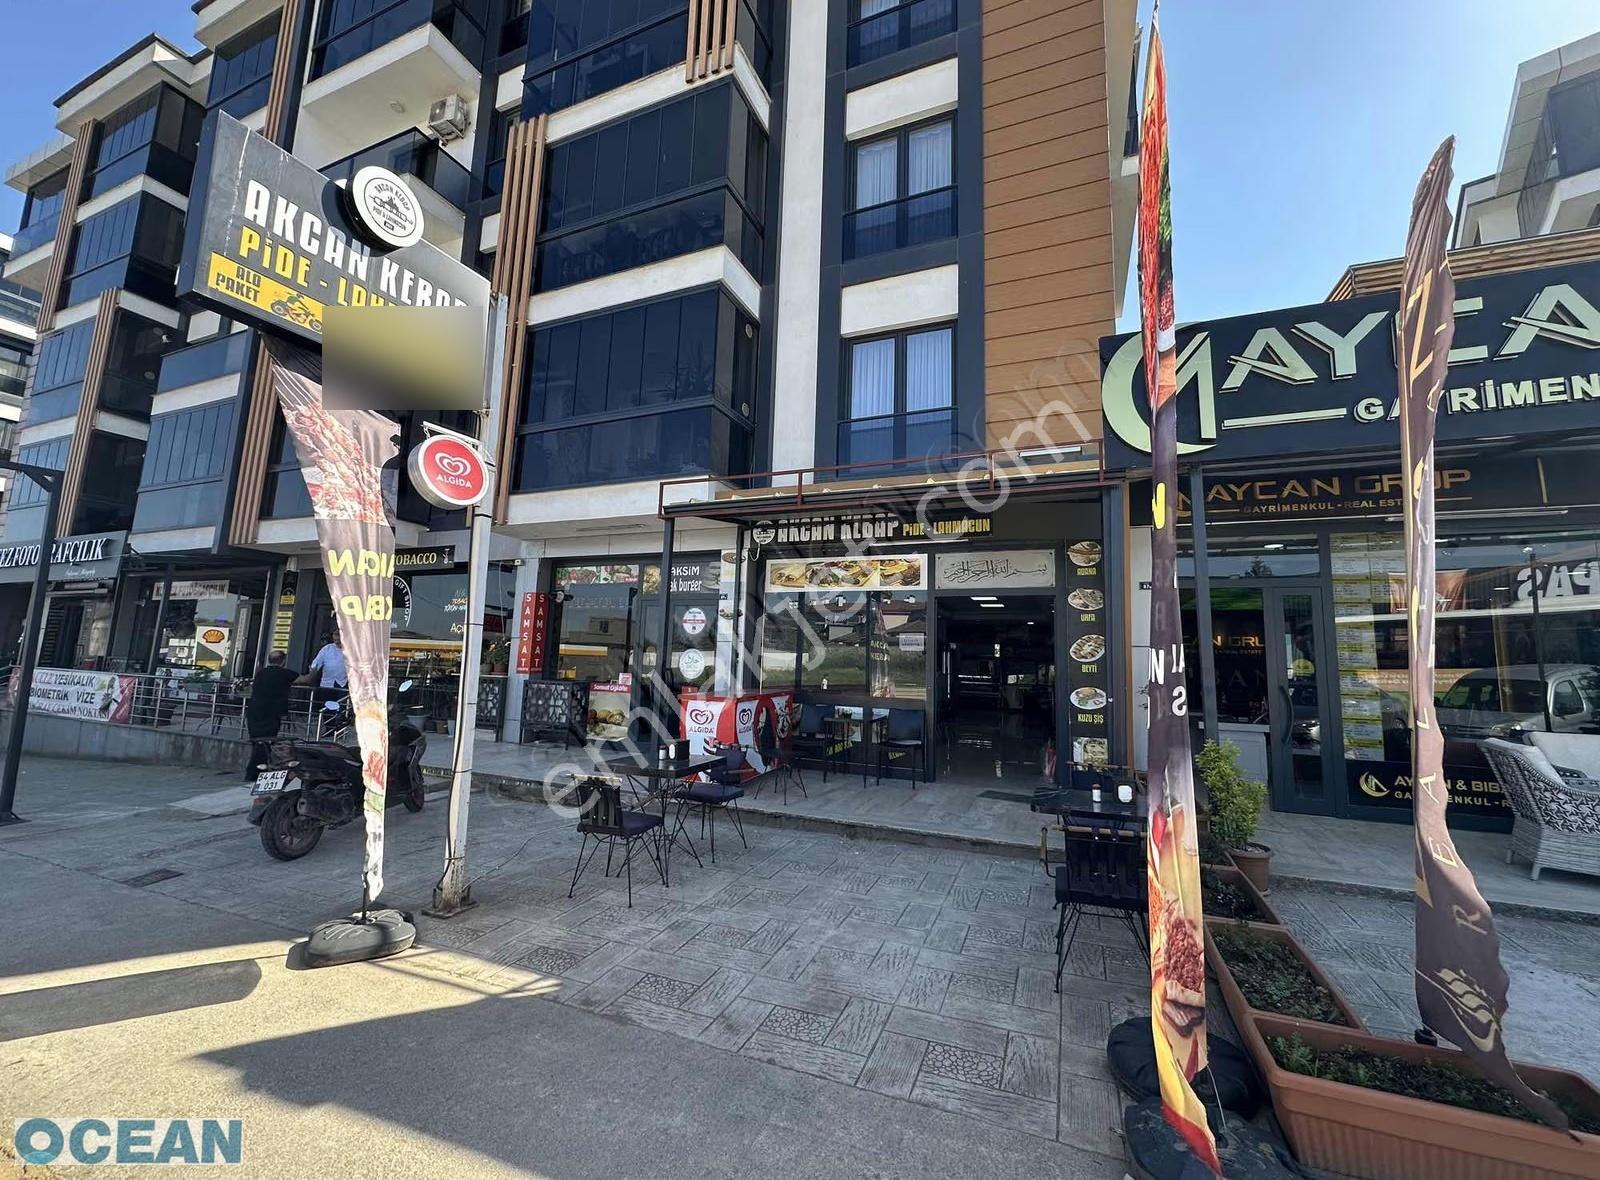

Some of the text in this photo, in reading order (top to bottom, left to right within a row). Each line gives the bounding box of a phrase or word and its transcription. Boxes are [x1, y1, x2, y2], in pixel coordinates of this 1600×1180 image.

[244, 179, 371, 281] AKCAN
[216, 272, 260, 302] PAKET
[236, 266, 260, 288] ALO
[436, 473, 472, 489] ALGIDA
[1207, 469, 1471, 501] AYCAN GRP
[395, 552, 437, 566] OBACCO
[394, 579, 408, 593] GIFT
[521, 593, 532, 667] SAMSAT
[535, 594, 545, 667] SAMSAT
[77, 689, 96, 704] VİZE
[689, 726, 714, 734] ALGIDA
